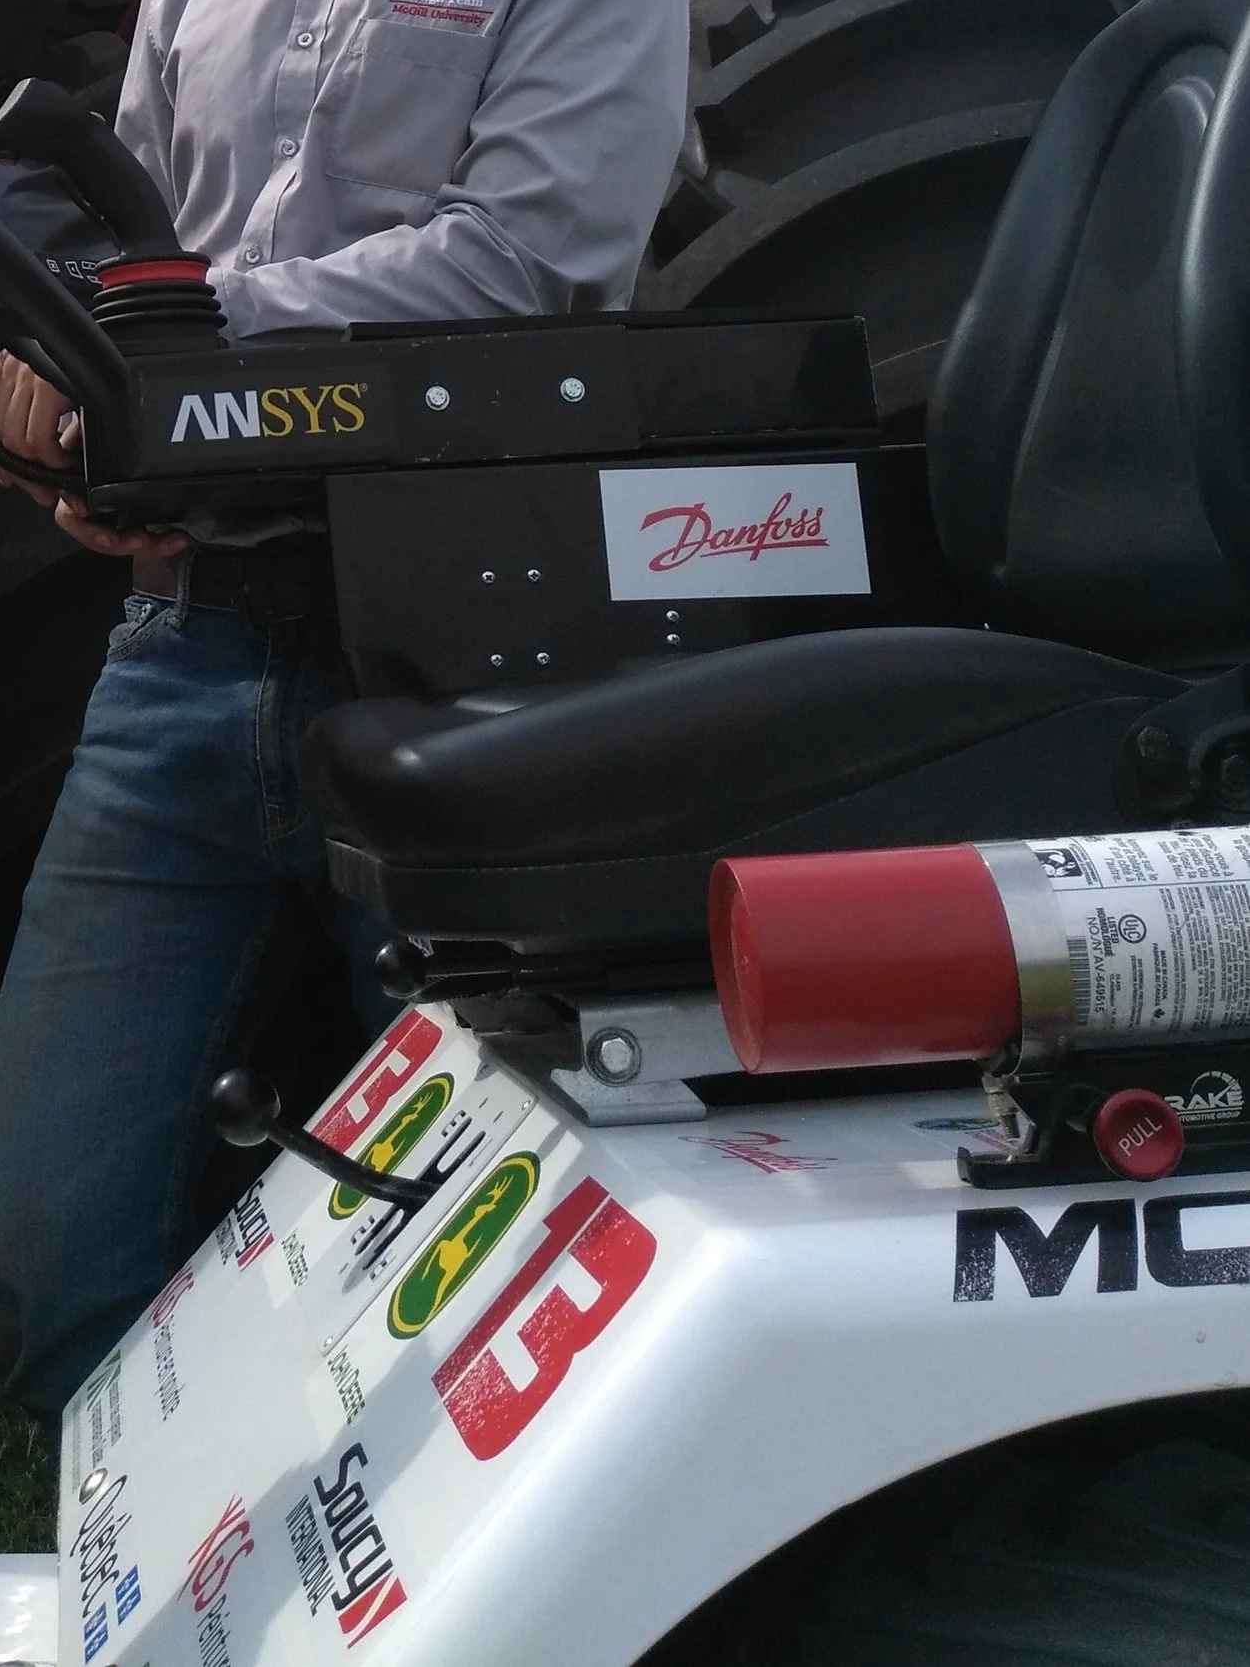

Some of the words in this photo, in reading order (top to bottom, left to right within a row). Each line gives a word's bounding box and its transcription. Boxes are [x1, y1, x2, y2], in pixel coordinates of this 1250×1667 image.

[391, 4, 429, 18] McGill
[430, 8, 486, 28] University
[170, 383, 364, 443] ANSYS
[640, 492, 830, 572] Danfoss
[1107, 916, 1120, 944] LISTED
[1164, 1090, 1245, 1111] RAKE
[1179, 1114, 1215, 1122] TOMOTIVE
[1118, 1117, 1163, 1157] PULL
[327, 1344, 353, 1387] JOHN
[337, 1368, 366, 1425] DEERE
[70, 1474, 132, 1618] Québec
[285, 1494, 336, 1617] INTERNATIONAL
